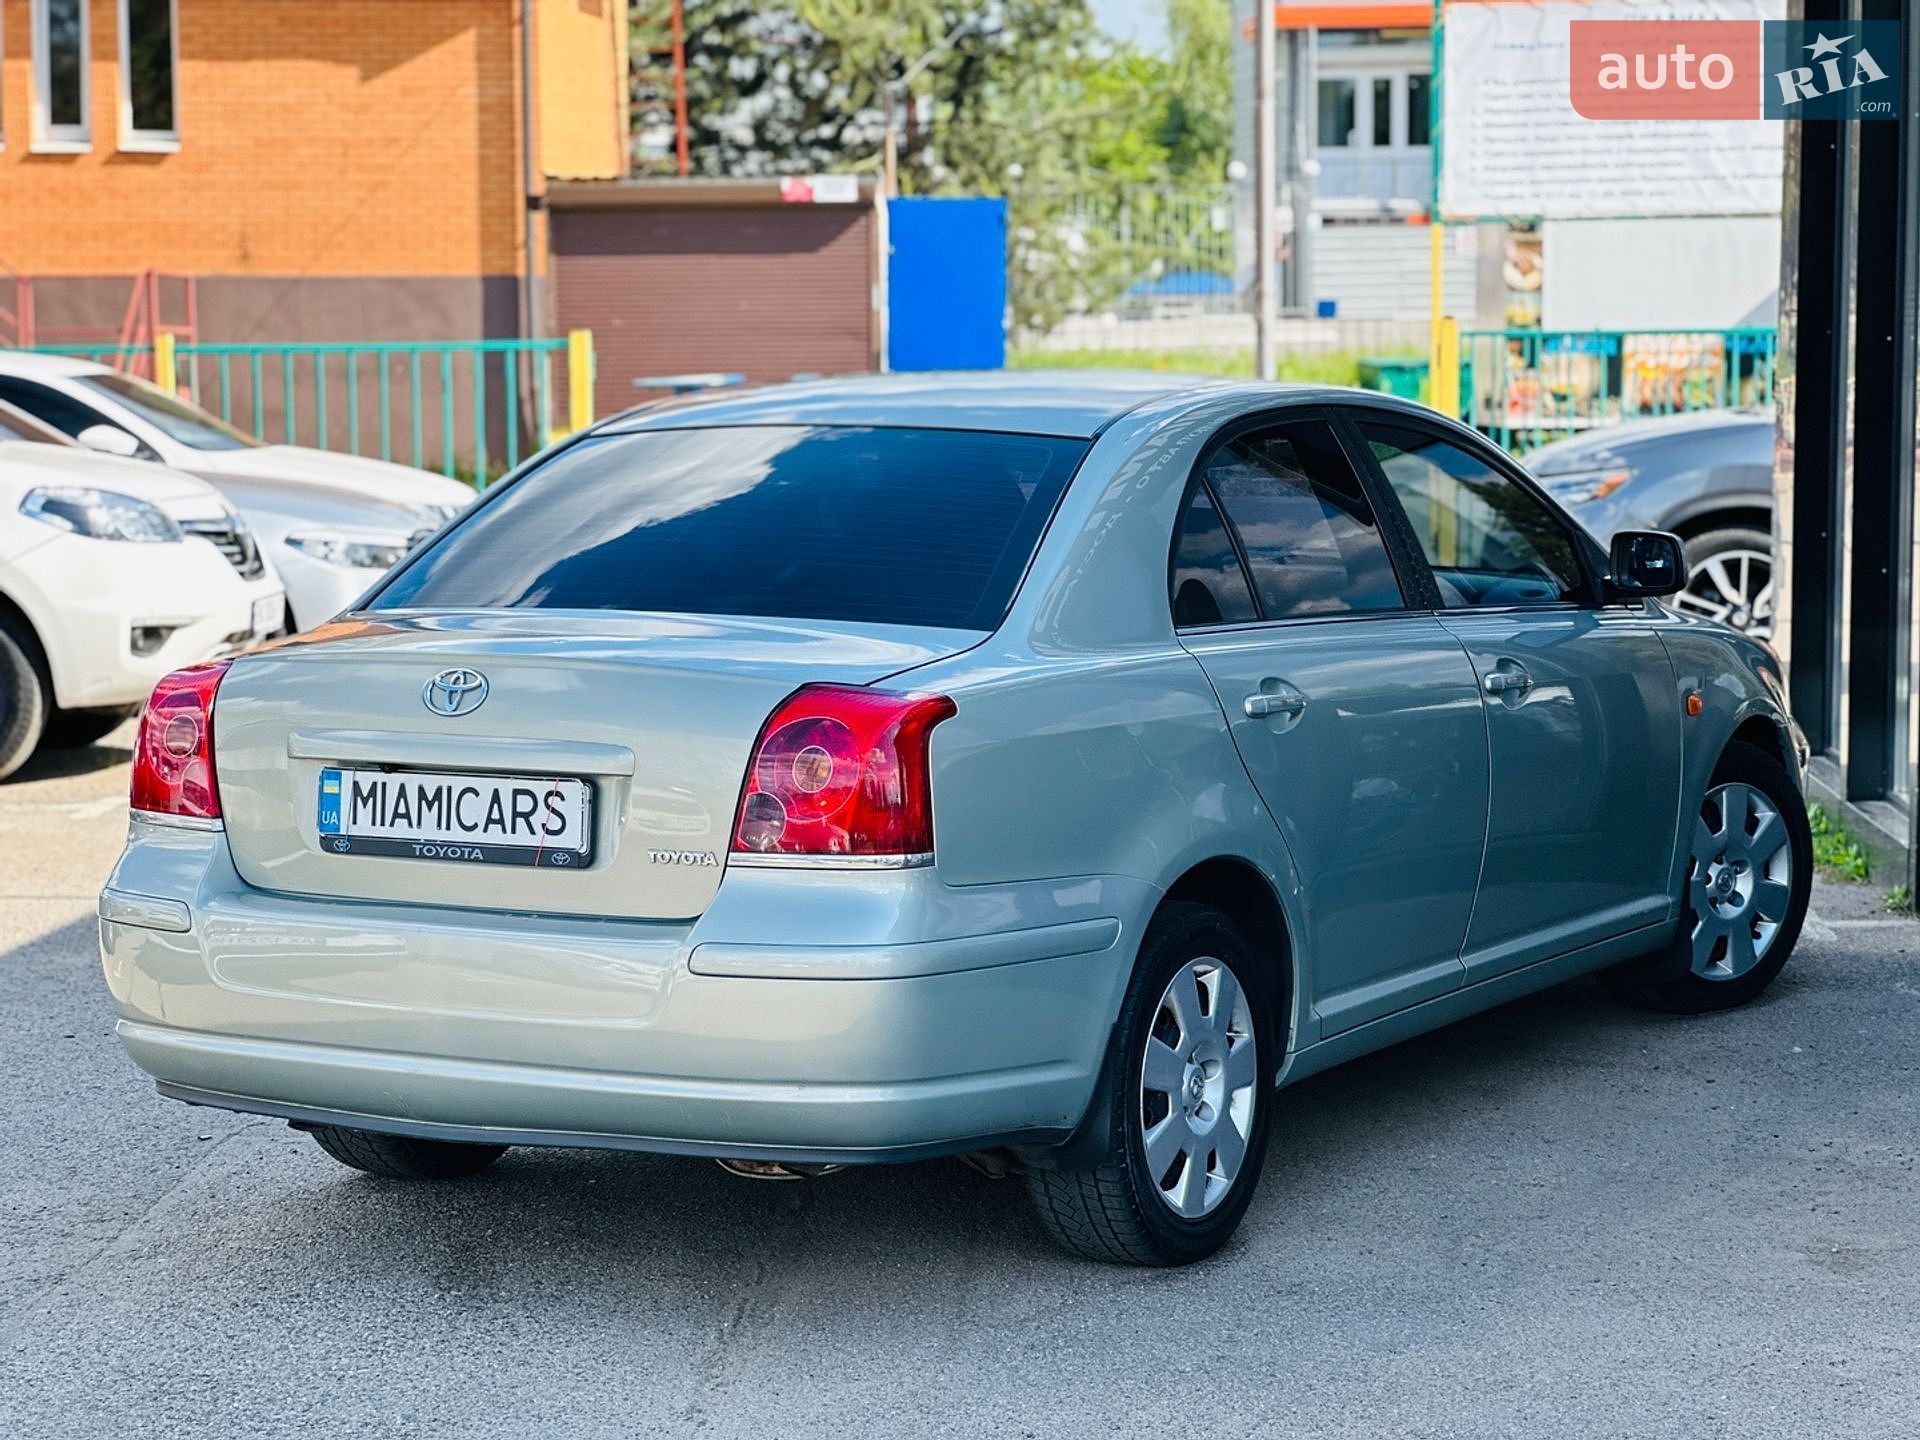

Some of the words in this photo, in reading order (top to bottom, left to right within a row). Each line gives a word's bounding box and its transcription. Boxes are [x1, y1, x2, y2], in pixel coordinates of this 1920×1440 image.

[321, 811, 339, 825] UA
[351, 780, 567, 836] MIAMICARS
[412, 844, 484, 861] TOYOTA
[648, 849, 719, 866] TOYOTA
